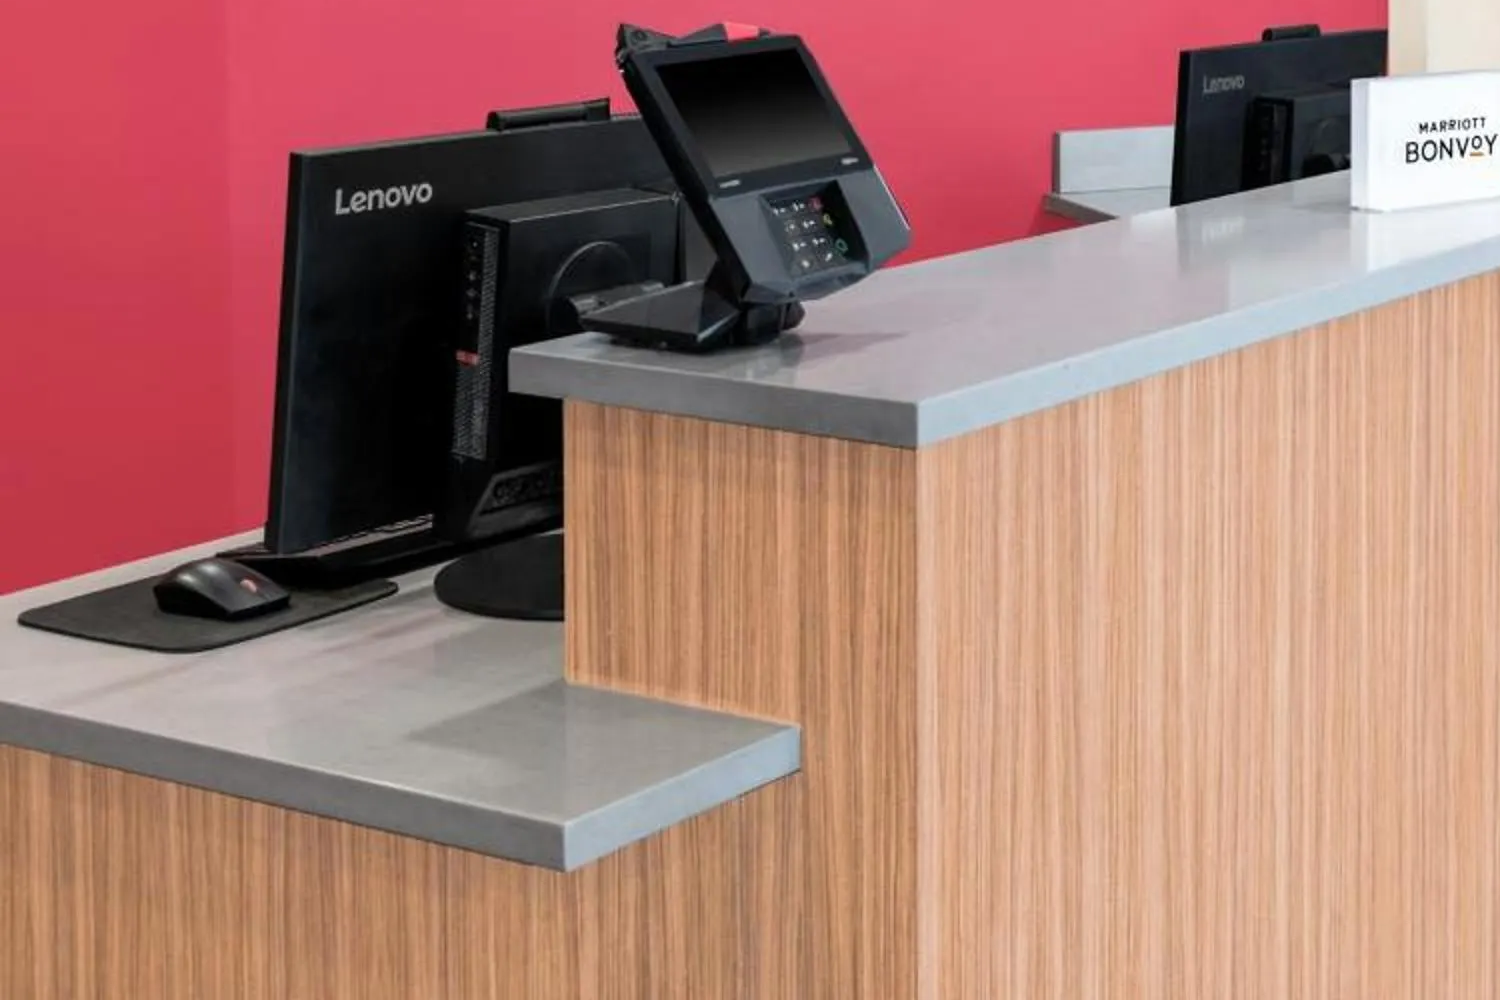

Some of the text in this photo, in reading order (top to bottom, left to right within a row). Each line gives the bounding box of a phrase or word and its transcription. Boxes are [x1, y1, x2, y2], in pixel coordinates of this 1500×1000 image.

[1203, 74, 1245, 94] Lenovo
[1418, 116, 1487, 135] MARRIOTT
[1405, 133, 1498, 164] BONVOY
[335, 182, 434, 216] Lenovo
